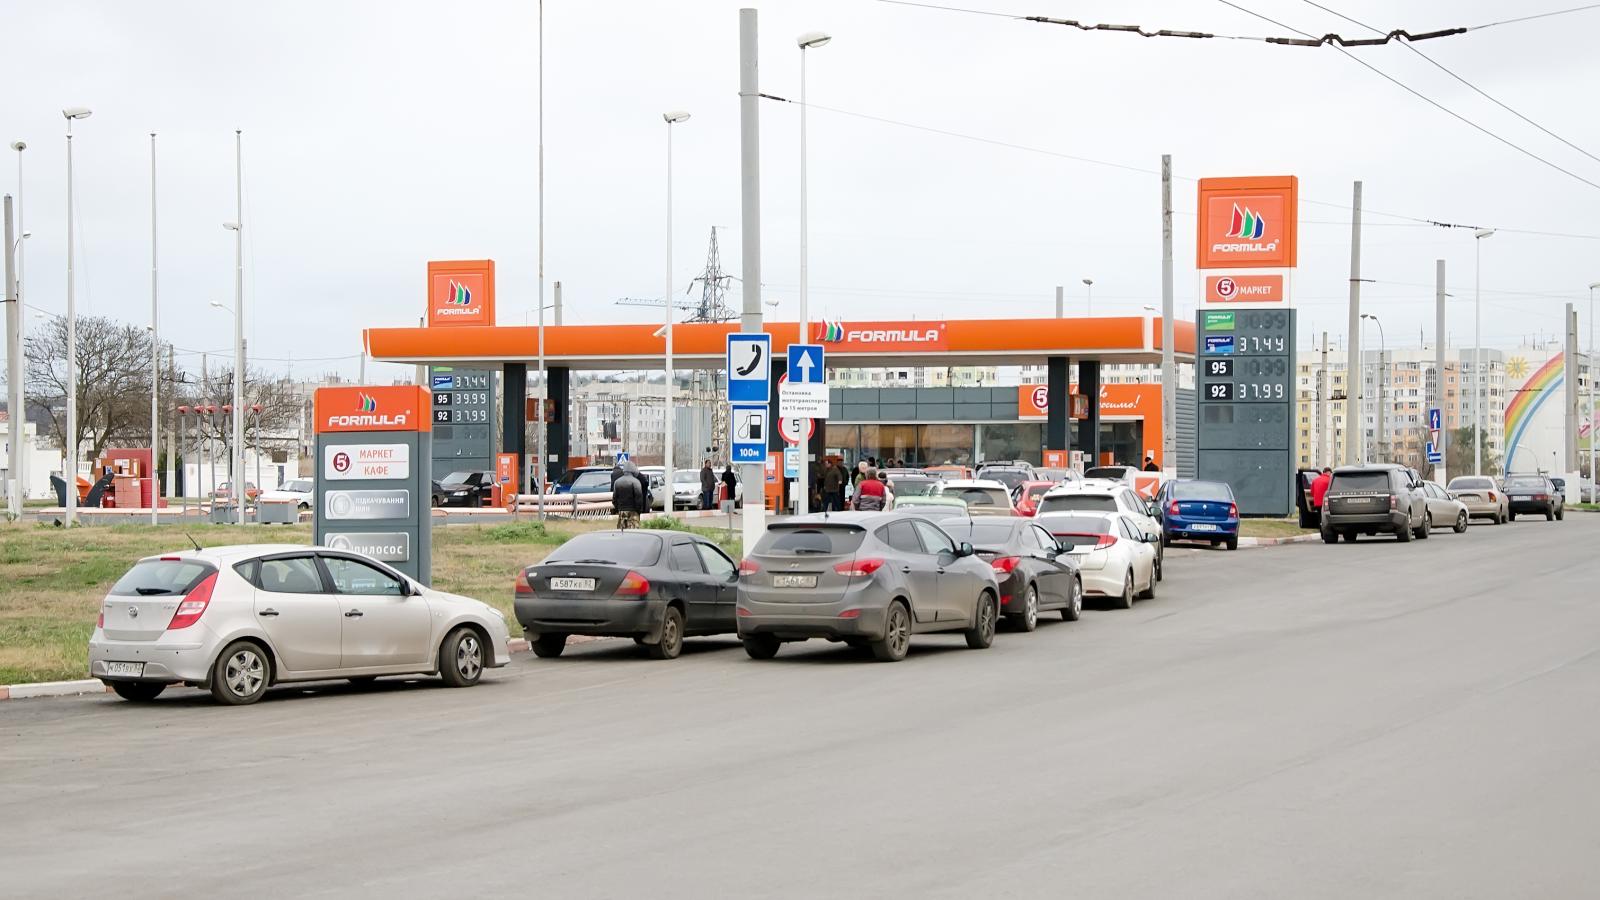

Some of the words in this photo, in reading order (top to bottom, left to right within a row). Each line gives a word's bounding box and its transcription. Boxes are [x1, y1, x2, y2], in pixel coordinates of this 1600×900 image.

[1212, 244, 1276, 252] FORMULA
[1240, 286, 1272, 295] МАРКЕТ
[847, 329, 939, 343] FORMULA
[1211, 362, 1227, 374] 95
[456, 376, 486, 387] 37.44
[1211, 385, 1226, 397] 92
[1239, 384, 1283, 399] 37.99
[437, 394, 448, 404] 95
[456, 393, 486, 405] 39.99
[328, 415, 406, 427] FORMULA
[437, 411, 448, 421] 92
[456, 410, 486, 421] 37.99
[792, 419, 800, 433] 5
[359, 449, 393, 459] МАРКЕТ
[739, 448, 760, 457] 100м
[364, 466, 389, 476] КАФЕ
[354, 545, 403, 555] ПИЛОСОС
